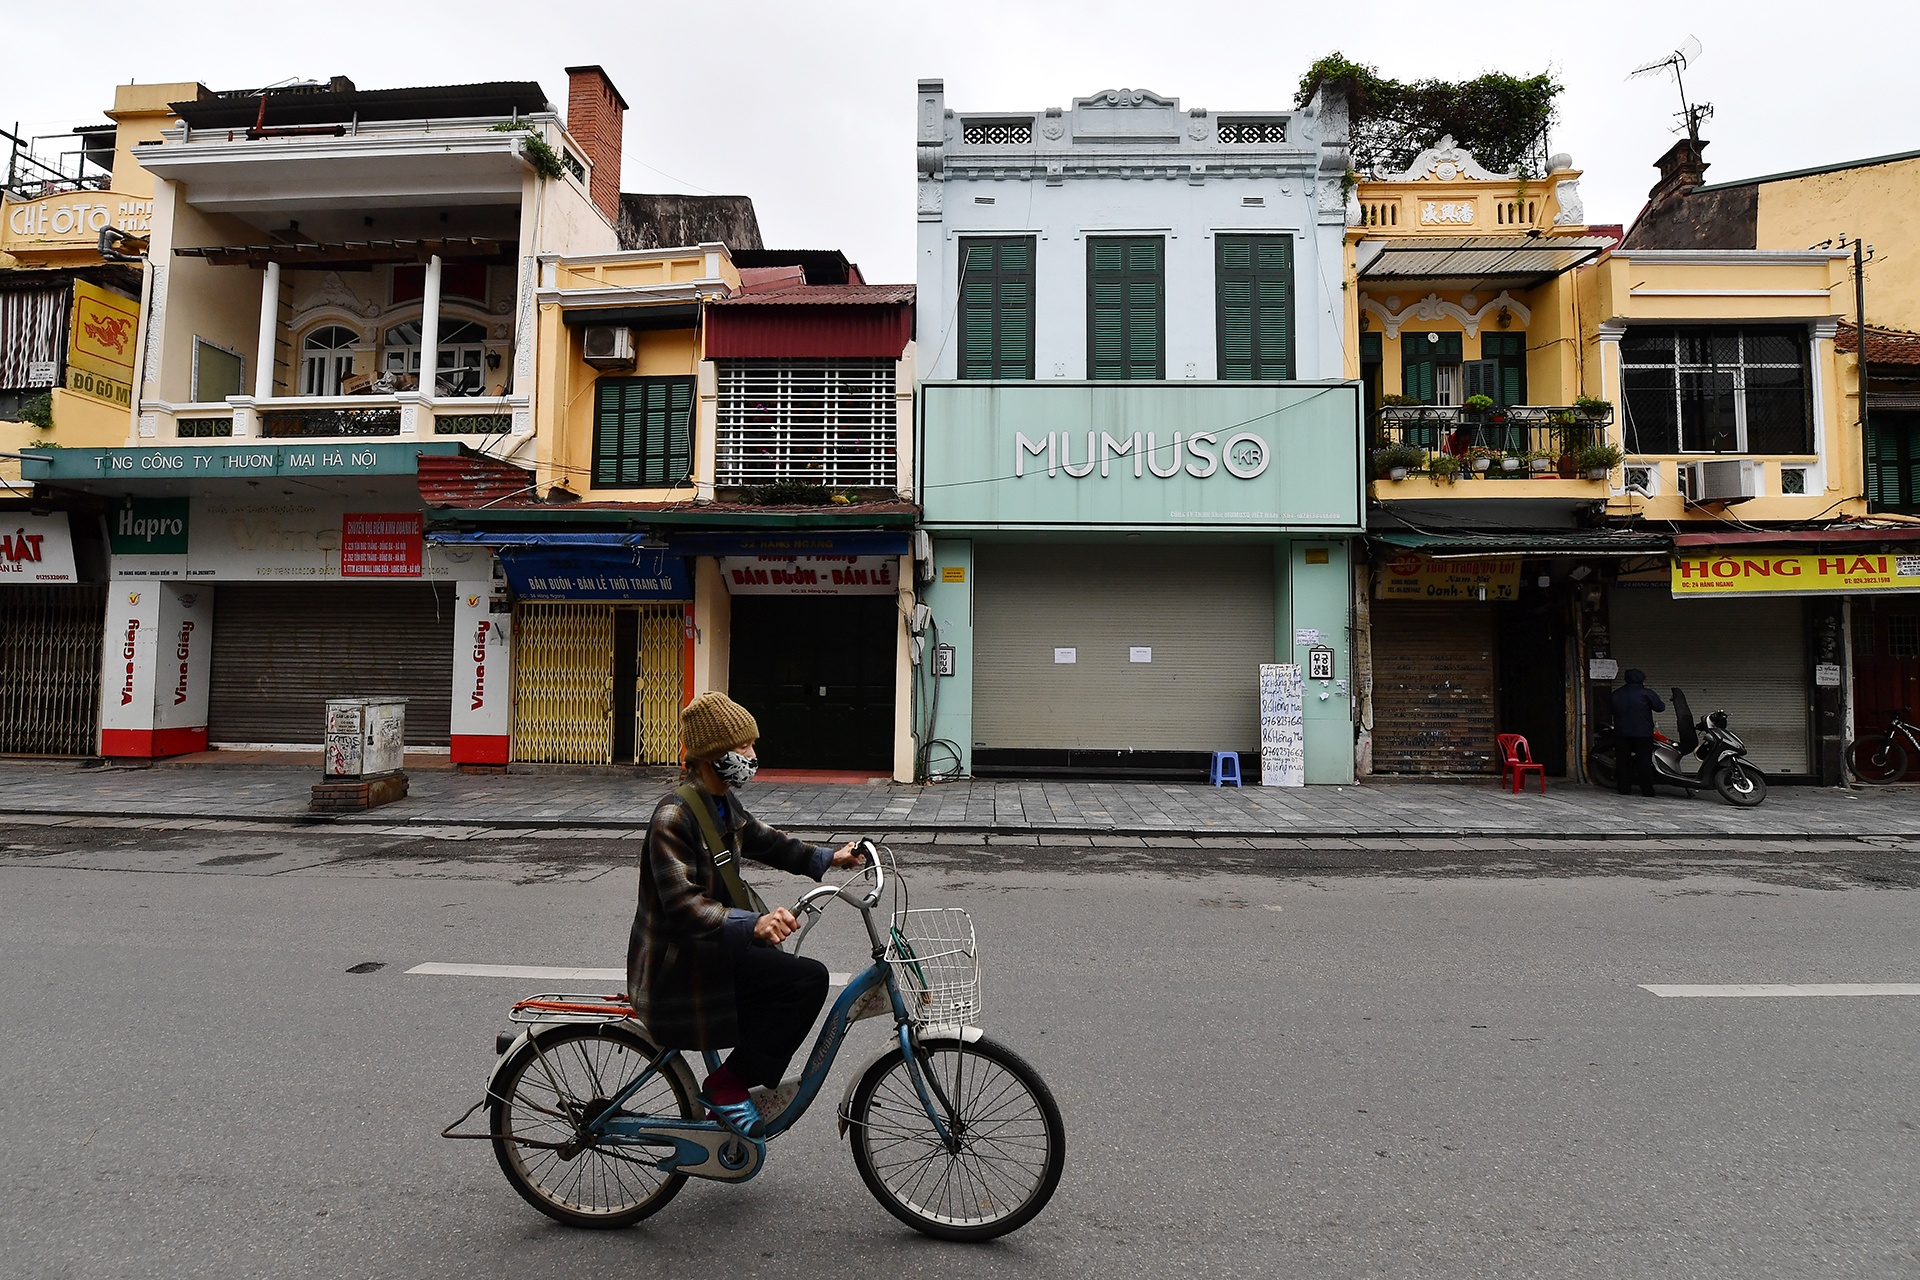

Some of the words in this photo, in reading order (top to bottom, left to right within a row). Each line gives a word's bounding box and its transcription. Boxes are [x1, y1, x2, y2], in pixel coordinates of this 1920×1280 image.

[141, 451, 184, 469] CÔNG
[193, 455, 213, 469] TY
[290, 454, 315, 470] MẠI
[323, 449, 343, 467] HÀ
[351, 449, 376, 470] NỘI
[1015, 430, 1271, 479] MUMUSO
[119, 509, 183, 542] Hapro
[528, 575, 547, 590] BÁN
[548, 575, 572, 590] BUÔN
[577, 575, 595, 590] BÁN
[597, 574, 607, 590] LẺ
[609, 575, 629, 590] THỜI
[630, 577, 658, 590] TRANG
[660, 575, 673, 590] NỮ
[731, 566, 769, 585] BÁN
[771, 565, 817, 585] BUÔN
[831, 566, 867, 585] BÁN
[871, 563, 890, 585] LẺ
[1427, 584, 1458, 597] Oanh
